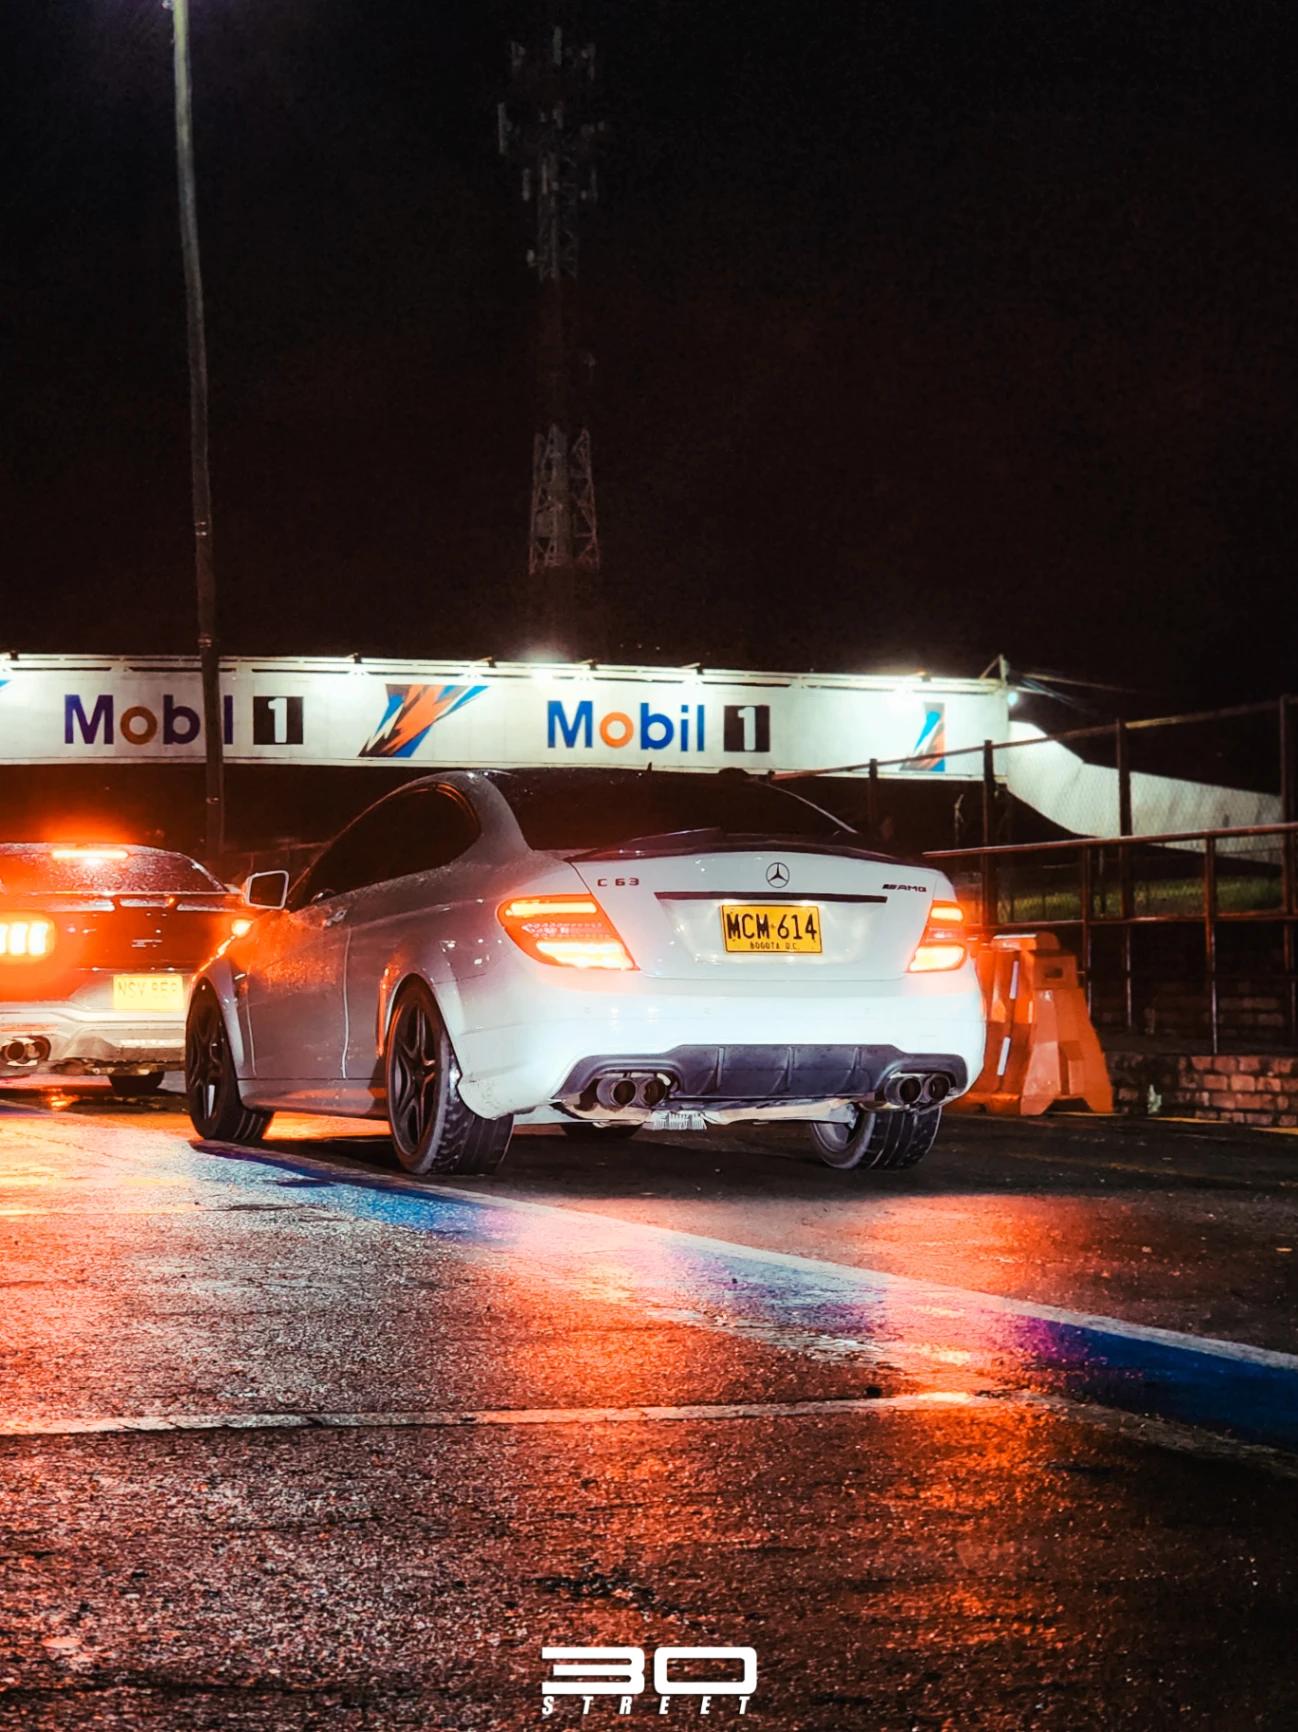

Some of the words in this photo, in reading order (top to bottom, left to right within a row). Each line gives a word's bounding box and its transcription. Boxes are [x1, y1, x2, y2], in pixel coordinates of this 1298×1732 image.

[64, 694, 234, 745] Mobl
[547, 700, 705, 752] Mobil
[597, 878, 608, 887] C
[615, 877, 640, 887] 63
[726, 912, 770, 940] MCM
[777, 913, 818, 941] 614
